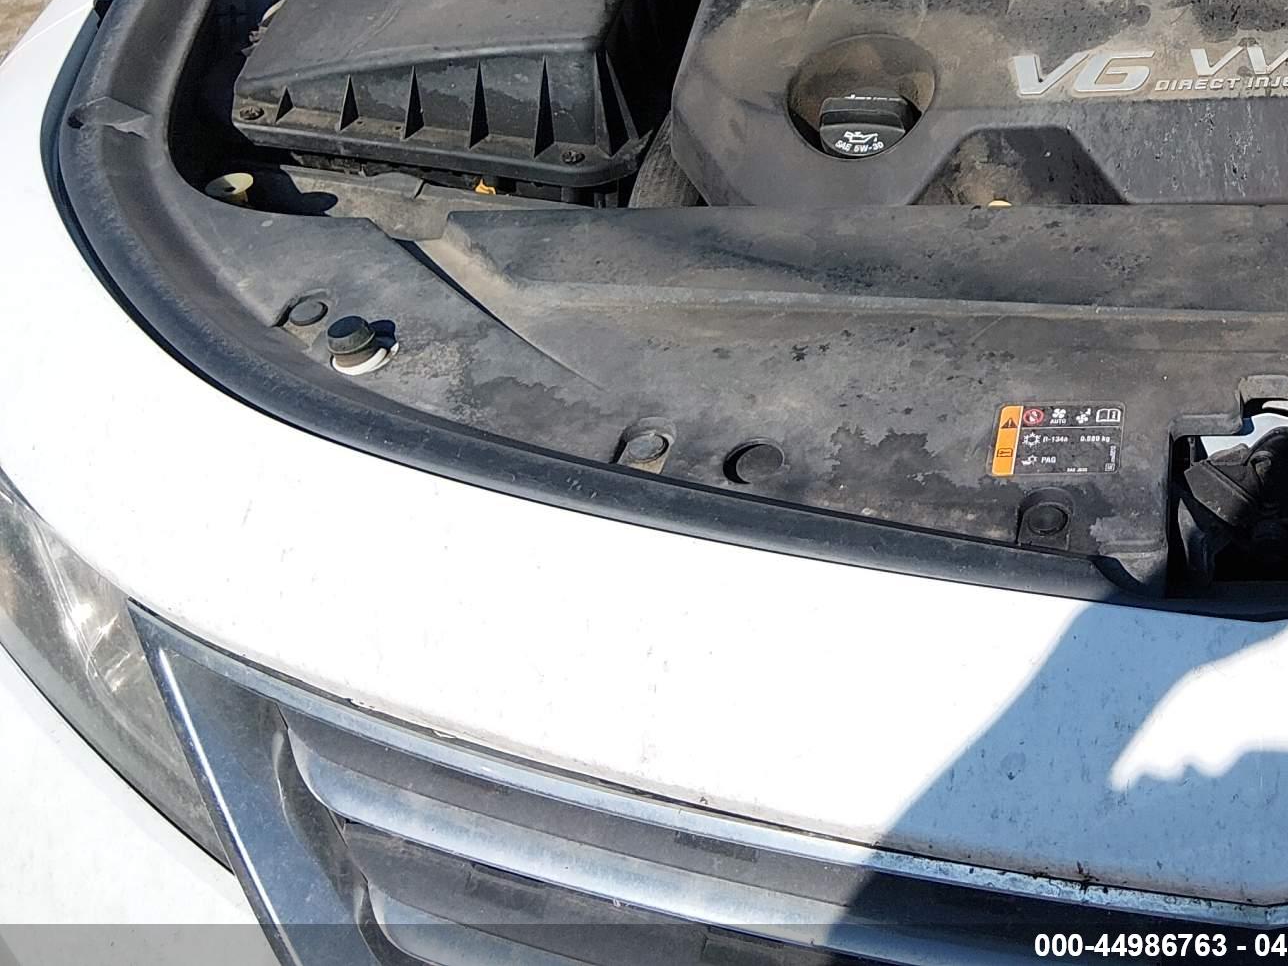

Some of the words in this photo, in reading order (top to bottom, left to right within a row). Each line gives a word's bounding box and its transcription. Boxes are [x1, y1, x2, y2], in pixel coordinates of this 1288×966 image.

[1014, 50, 1156, 95] V6
[1154, 77, 1241, 92] DIRECT
[835, 140, 853, 152] SAE
[853, 141, 885, 153] 5W-30
[1101, 435, 1111, 443] kg
[1041, 456, 1057, 464] PAG
